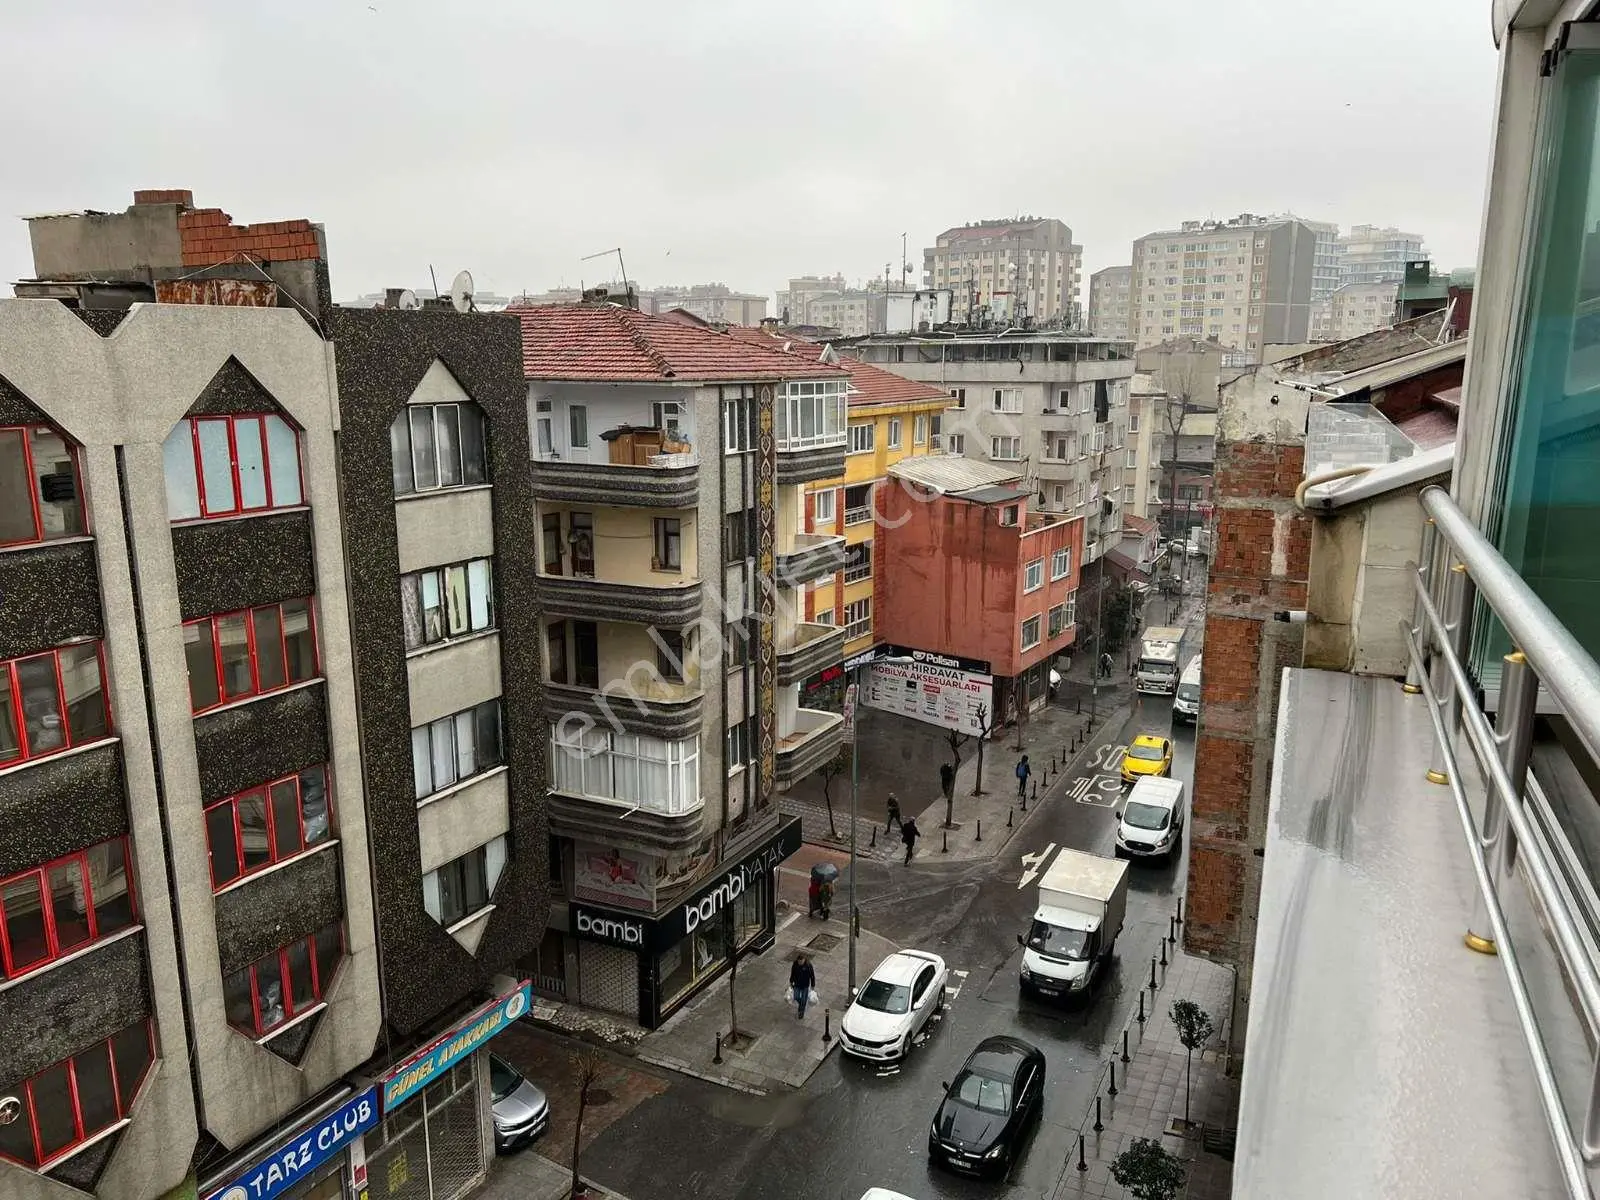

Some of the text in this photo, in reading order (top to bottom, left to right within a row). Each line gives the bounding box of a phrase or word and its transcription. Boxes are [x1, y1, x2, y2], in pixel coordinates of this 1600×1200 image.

[912, 662, 965, 681] HIRDAVAT
[926, 653, 959, 668] Polisan
[685, 865, 745, 934] bambi
[745, 839, 786, 887] YATAK
[577, 909, 643, 945] bambi
[249, 1100, 371, 1197] TARZ CLUB
